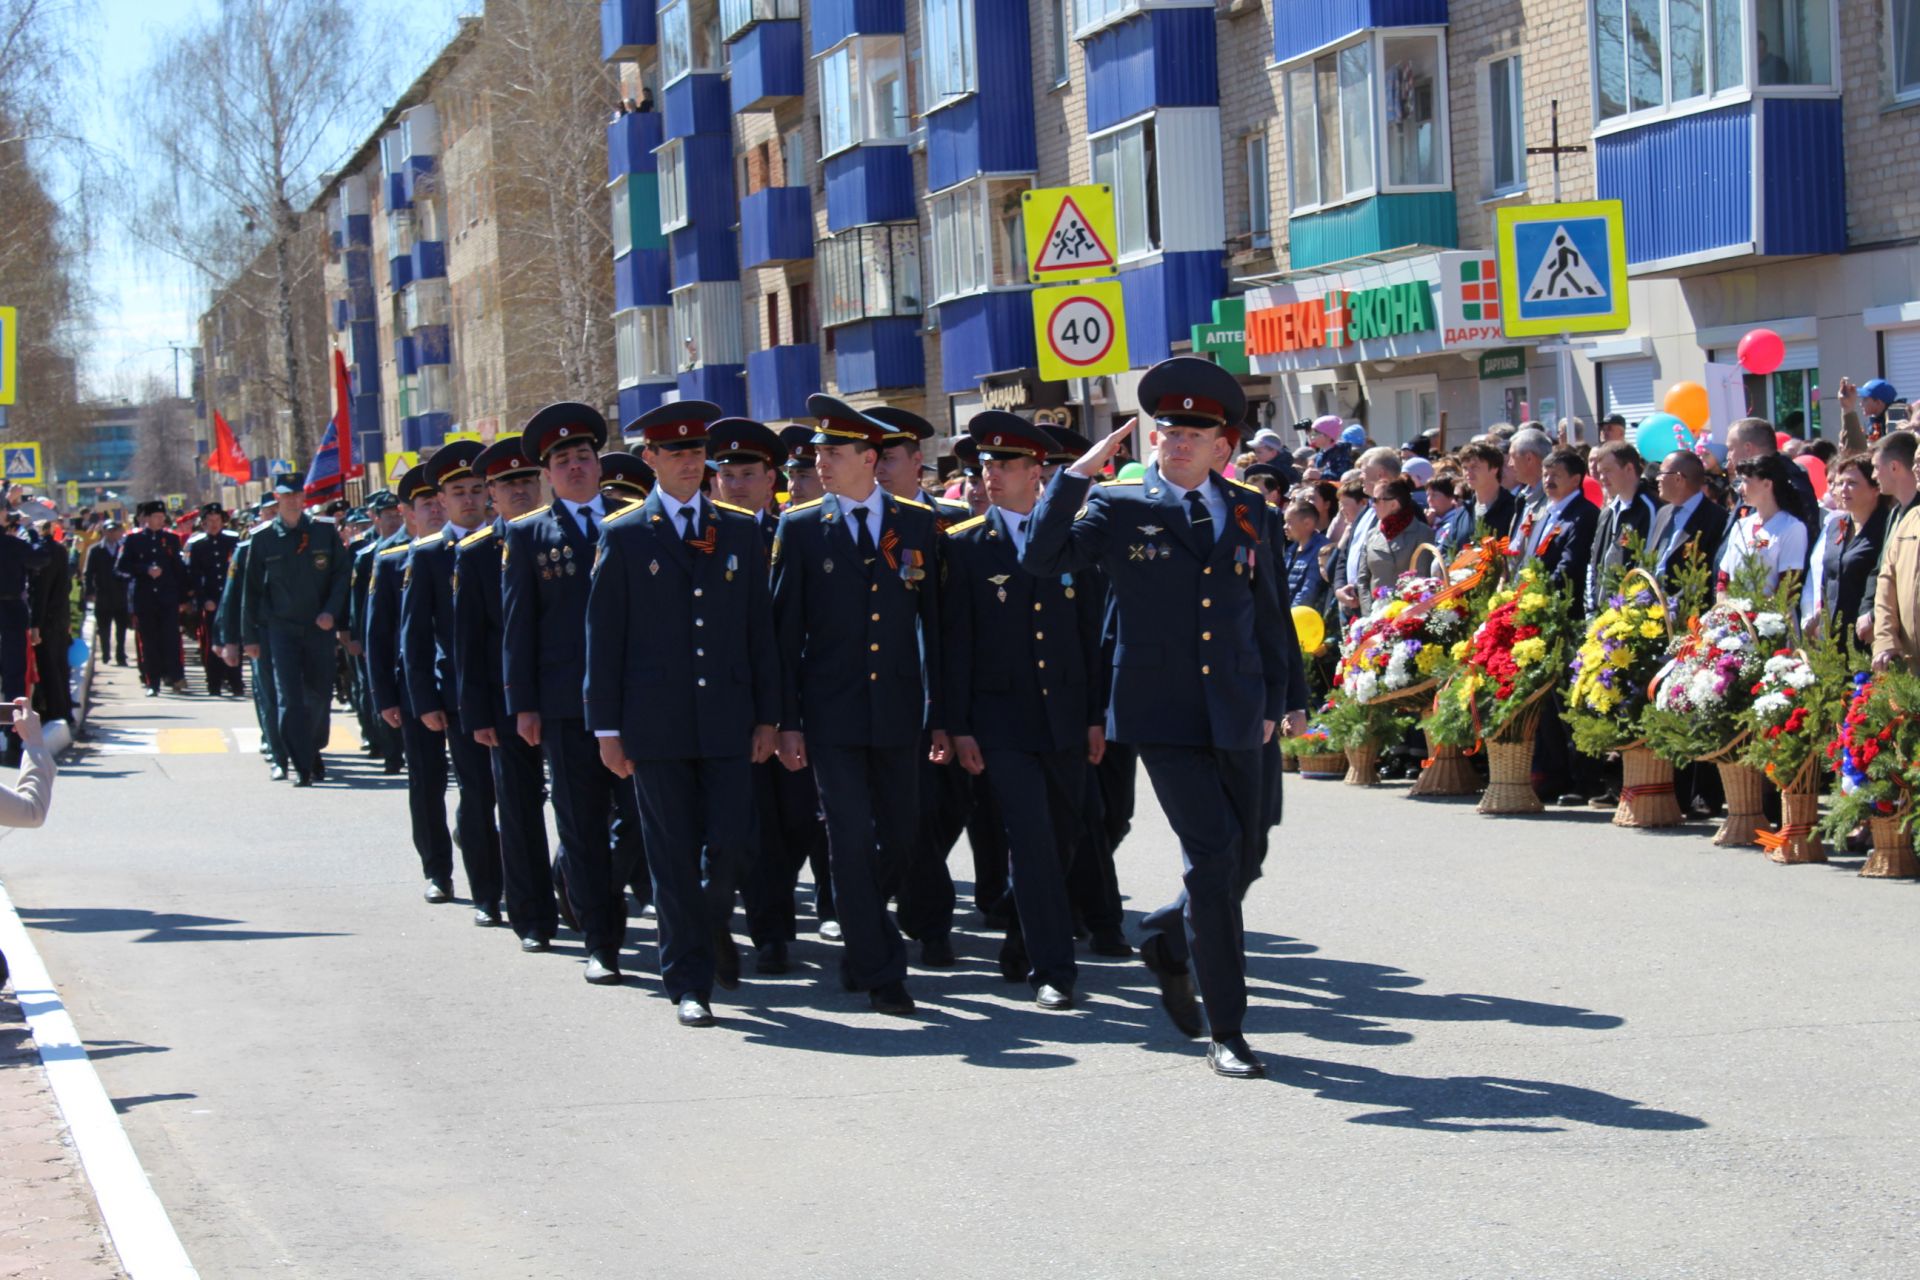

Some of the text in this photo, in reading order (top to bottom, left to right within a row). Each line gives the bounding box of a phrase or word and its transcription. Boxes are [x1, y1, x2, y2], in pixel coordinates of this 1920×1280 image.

[1061, 316, 1100, 345] 40
[1245, 280, 1430, 356] АПТЕКА ЭКОНА
